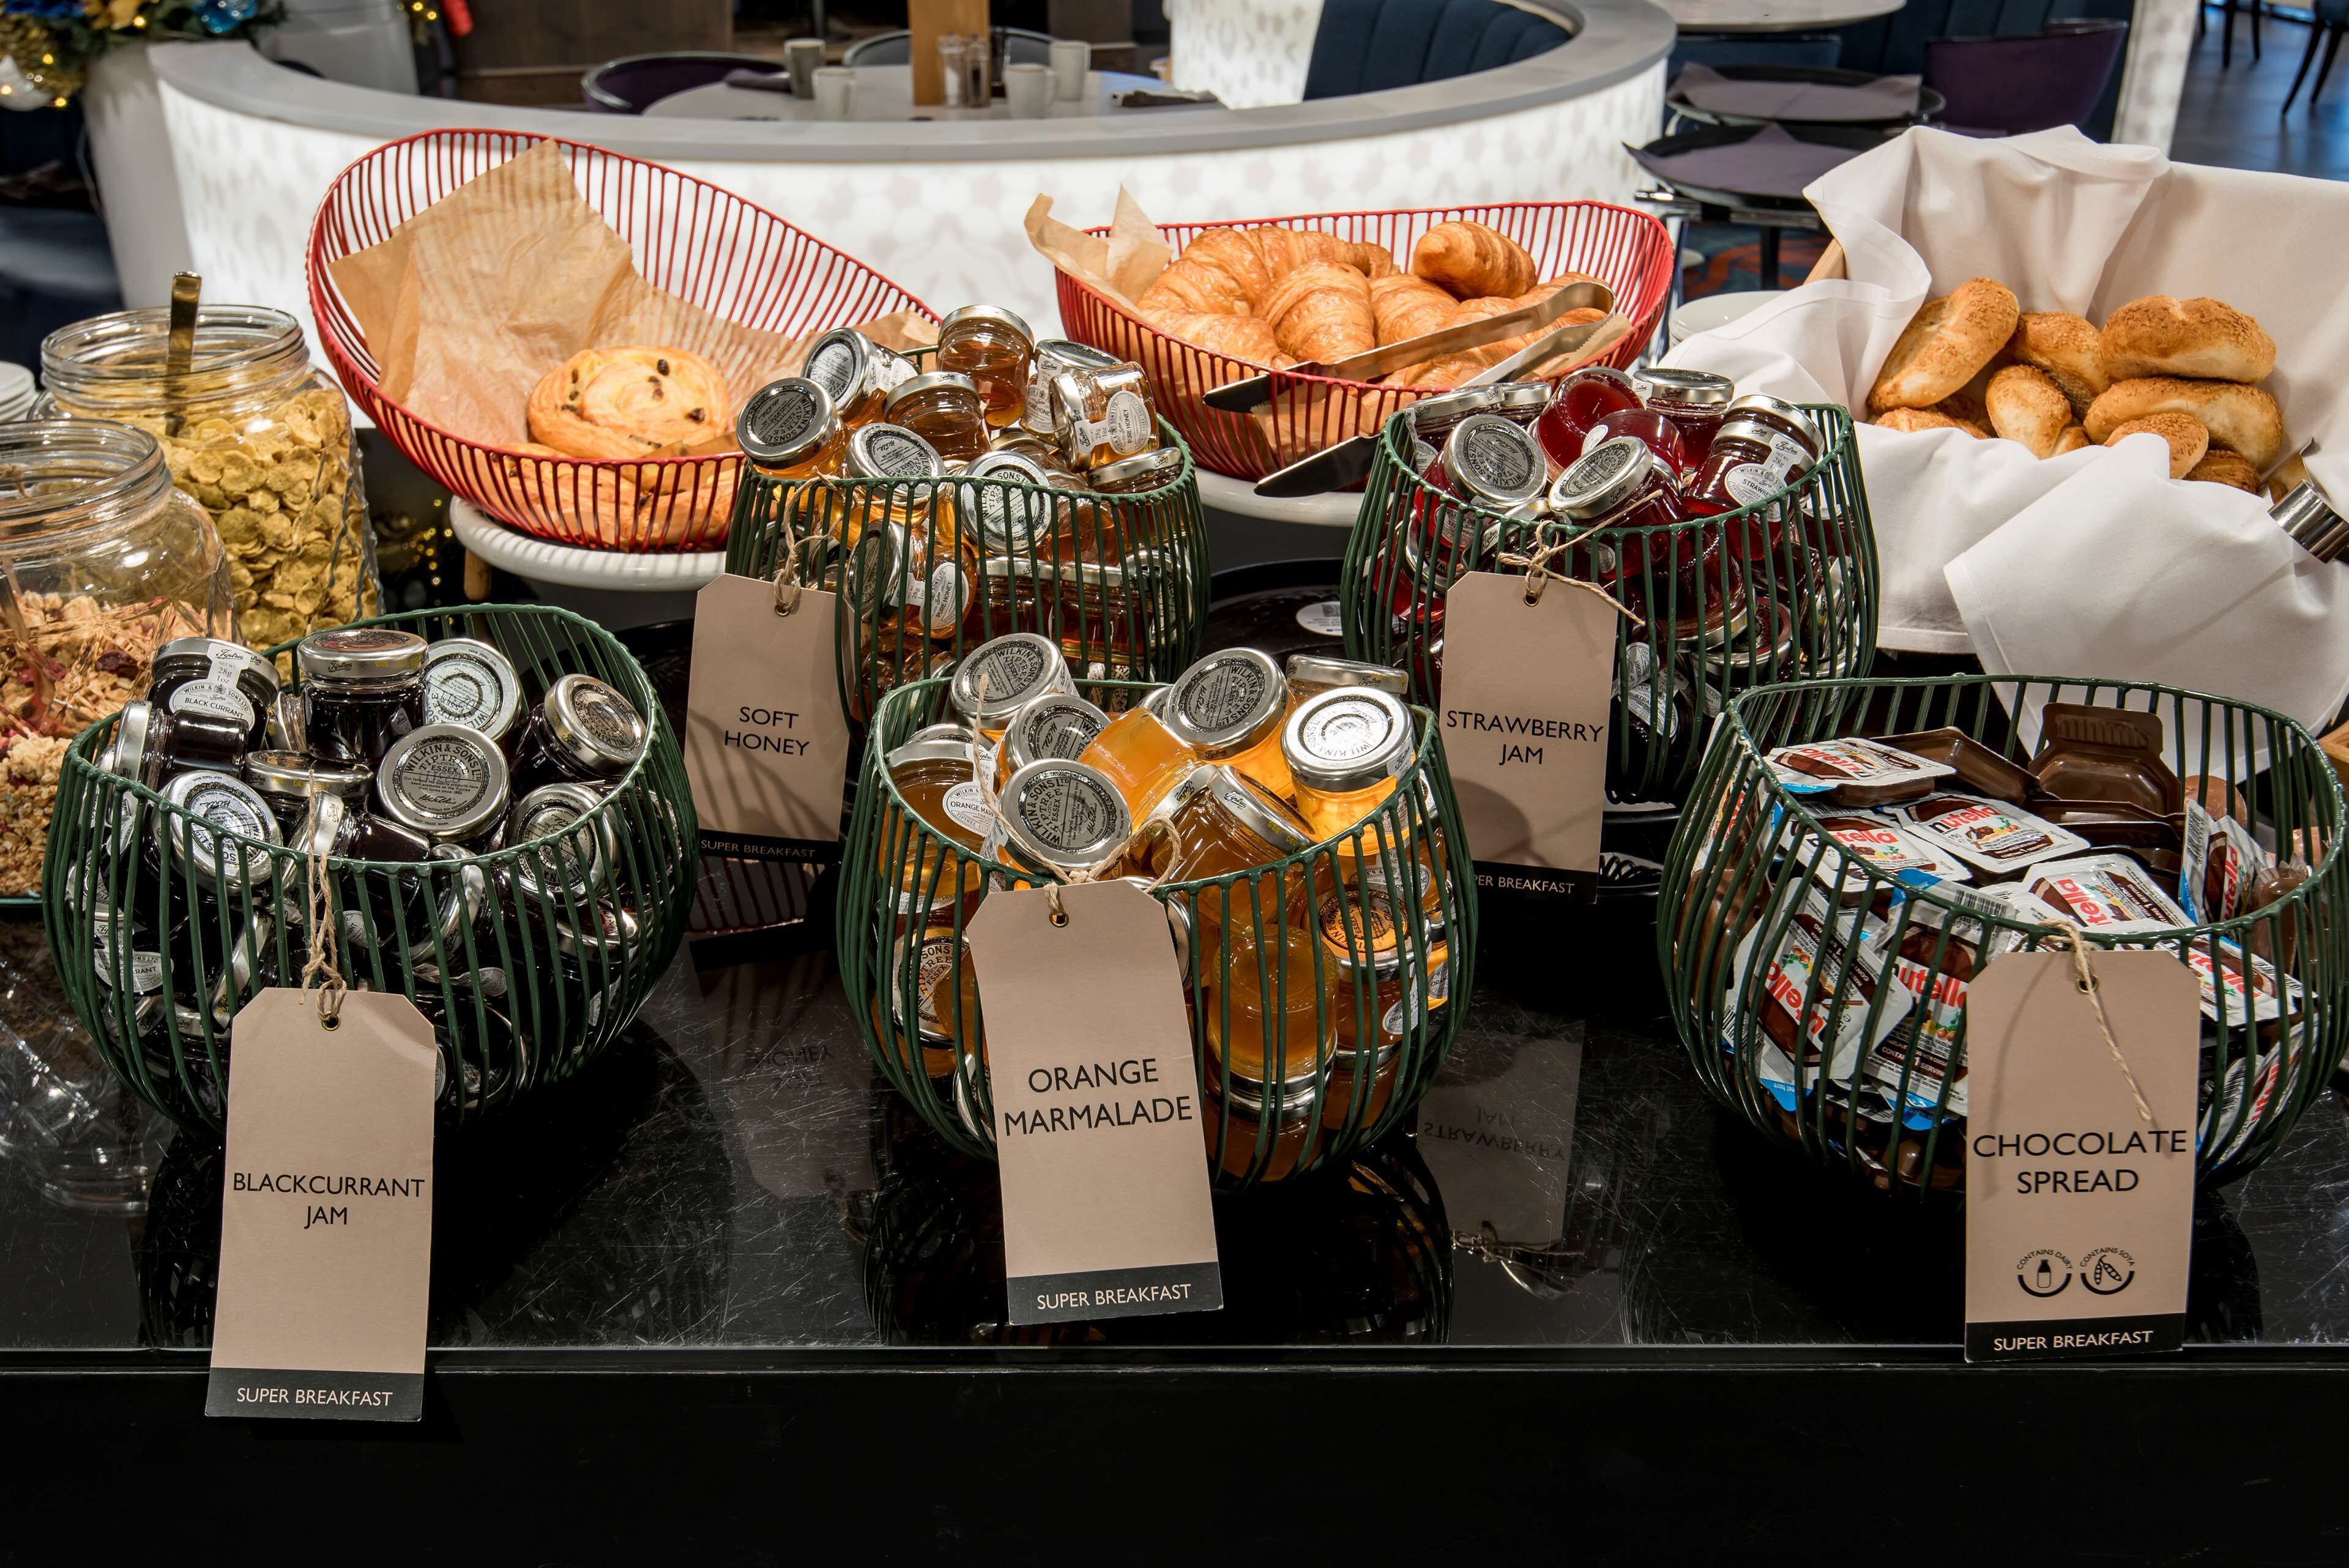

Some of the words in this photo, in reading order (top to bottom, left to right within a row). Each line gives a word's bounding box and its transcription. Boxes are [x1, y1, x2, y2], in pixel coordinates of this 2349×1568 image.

[800, 396, 811, 425] WILKIN
[773, 430, 797, 442] SONS
[1776, 441, 1798, 455] Tiptree
[1469, 453, 1485, 475] SONS
[997, 472, 1021, 481] SONS
[1493, 474, 1524, 486] WILKIN
[1742, 479, 1771, 497] STRAWBE
[936, 603, 945, 618] PURE
[943, 581, 953, 603] HONEY
[215, 649, 244, 660] Tiptree
[218, 667, 232, 677] 28g
[328, 660, 352, 671] Tiptree
[997, 648, 1033, 660] WILKIN
[1024, 662, 1038, 683] SONS
[1003, 656, 1028, 683] TIPTREE
[217, 675, 229, 684] 1oz
[1231, 666, 1257, 689] WILKIN
[1358, 675, 1381, 686] Tiptree
[184, 685, 204, 693] WILKIN
[227, 691, 242, 702] SONS
[185, 697, 209, 707] BLACK
[210, 703, 244, 719] CURRANT
[739, 707, 799, 729] SOFT
[1230, 697, 1254, 721] SONS
[467, 713, 488, 729] WIL
[1447, 710, 1604, 741] STRAWBERRY
[724, 730, 810, 756] HONEY
[404, 744, 442, 771] WILKIN
[453, 746, 478, 768] SONS
[419, 754, 469, 775] TIPTREE
[1499, 744, 1543, 765] JAM
[431, 765, 458, 773] ESSEX
[955, 787, 973, 797] WILKIN
[1030, 780, 1055, 801] SONS
[1056, 778, 1070, 787] LTD
[950, 801, 980, 811] ORANGE
[1051, 798, 1061, 822] ESSEX
[1223, 790, 1247, 809] Tiptree
[1039, 788, 1063, 833] TIPTREE
[1929, 805, 2002, 834] nutella
[1027, 809, 1061, 845] WILKIN
[1267, 820, 1281, 834] BBE
[207, 843, 236, 861] SOS
[701, 840, 739, 852] SUPER
[744, 844, 816, 857] BREAKFAST
[1474, 874, 1494, 886] PER
[1498, 877, 1575, 894] BREAKFAST
[2223, 845, 2238, 923] utella
[2055, 879, 2113, 926] tella
[921, 945, 951, 959] SONS
[119, 966, 157, 975] CRANT
[920, 956, 953, 994] TIPTREE
[926, 964, 948, 986] ESSEX
[1029, 1058, 1158, 1093] ORANGE
[1004, 1096, 1193, 1136] MARMALADE
[1973, 1130, 2187, 1157] CHOCOLATE
[233, 1173, 425, 1197] BLACKCURRANT
[2017, 1169, 2139, 1194] SPREAD
[304, 1206, 348, 1229] JAM
[2017, 1249, 2055, 1270] CONTAINS
[2055, 1252, 2074, 1270] DAIRY
[2080, 1247, 2118, 1267] CONTAINS
[2118, 1249, 2135, 1267] SOYA
[1037, 1291, 1090, 1309] SUPER
[1096, 1284, 1191, 1306] BREAKFAST
[1993, 1336, 2048, 1351] SUPER
[2053, 1331, 2154, 1348] BREAKFAST
[237, 1388, 289, 1403] SUPER
[296, 1389, 393, 1406] BREAKFAST
